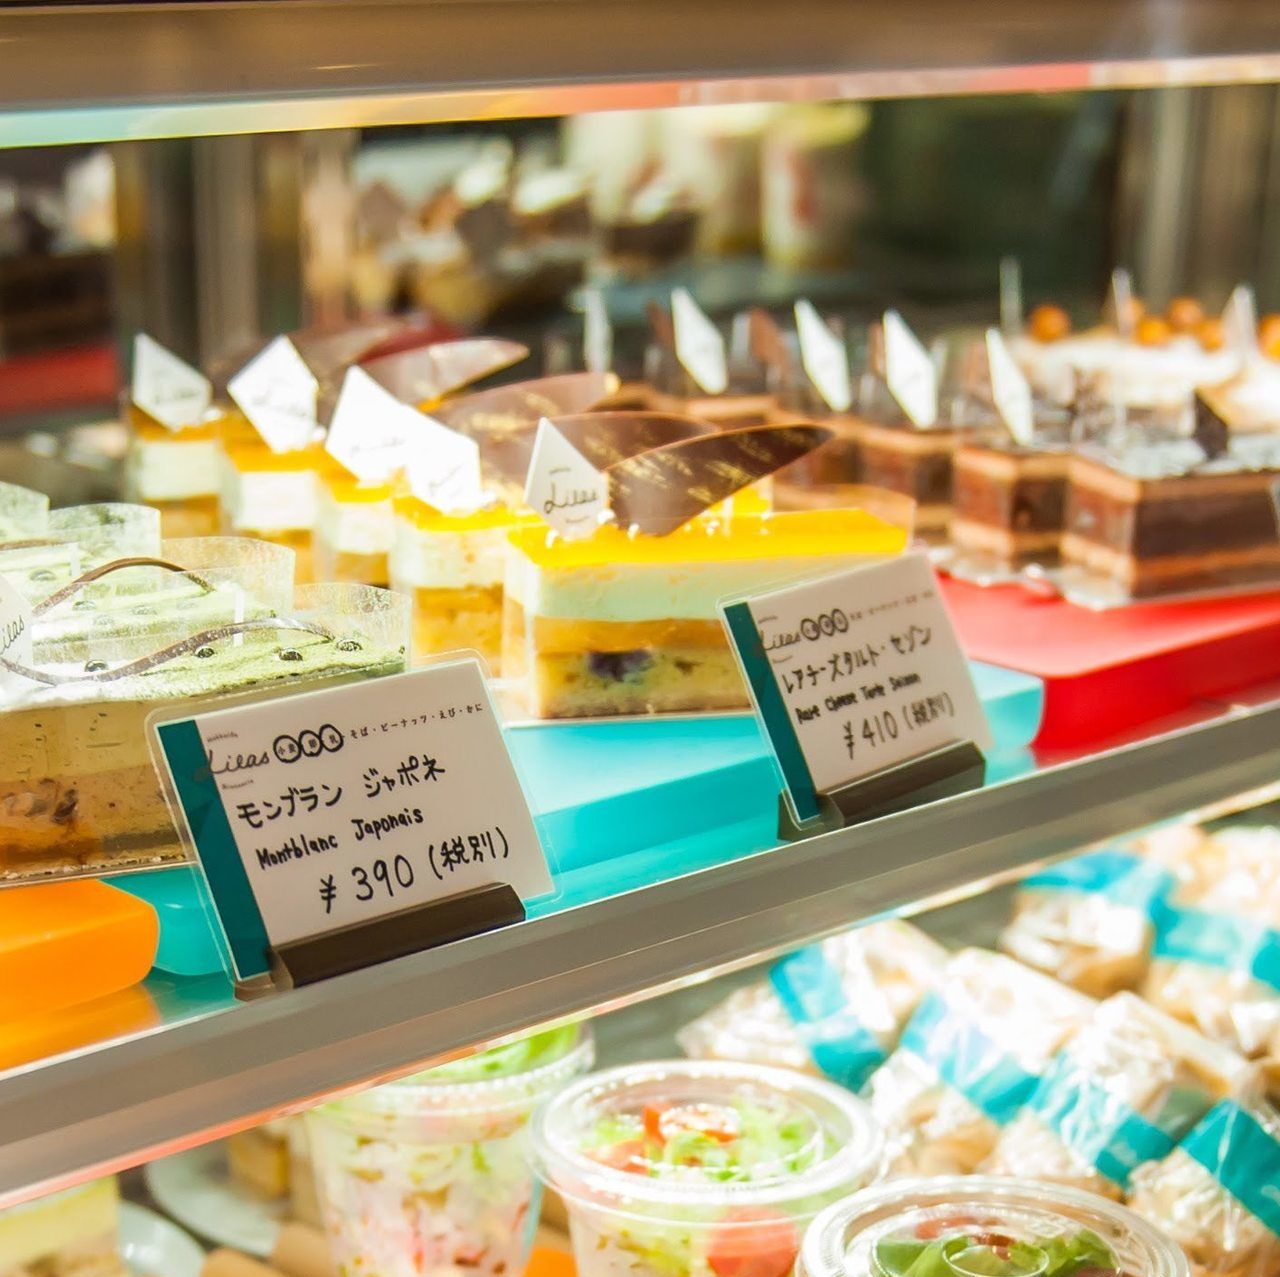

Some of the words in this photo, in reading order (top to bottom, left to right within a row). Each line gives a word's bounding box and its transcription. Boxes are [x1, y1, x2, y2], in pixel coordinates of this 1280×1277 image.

[206, 749, 270, 775] Lilas
[236, 784, 342, 829] モンブラン
[362, 754, 446, 798] ジャポネ
[256, 833, 339, 870] Montblanc
[351, 807, 424, 840] Japonais
